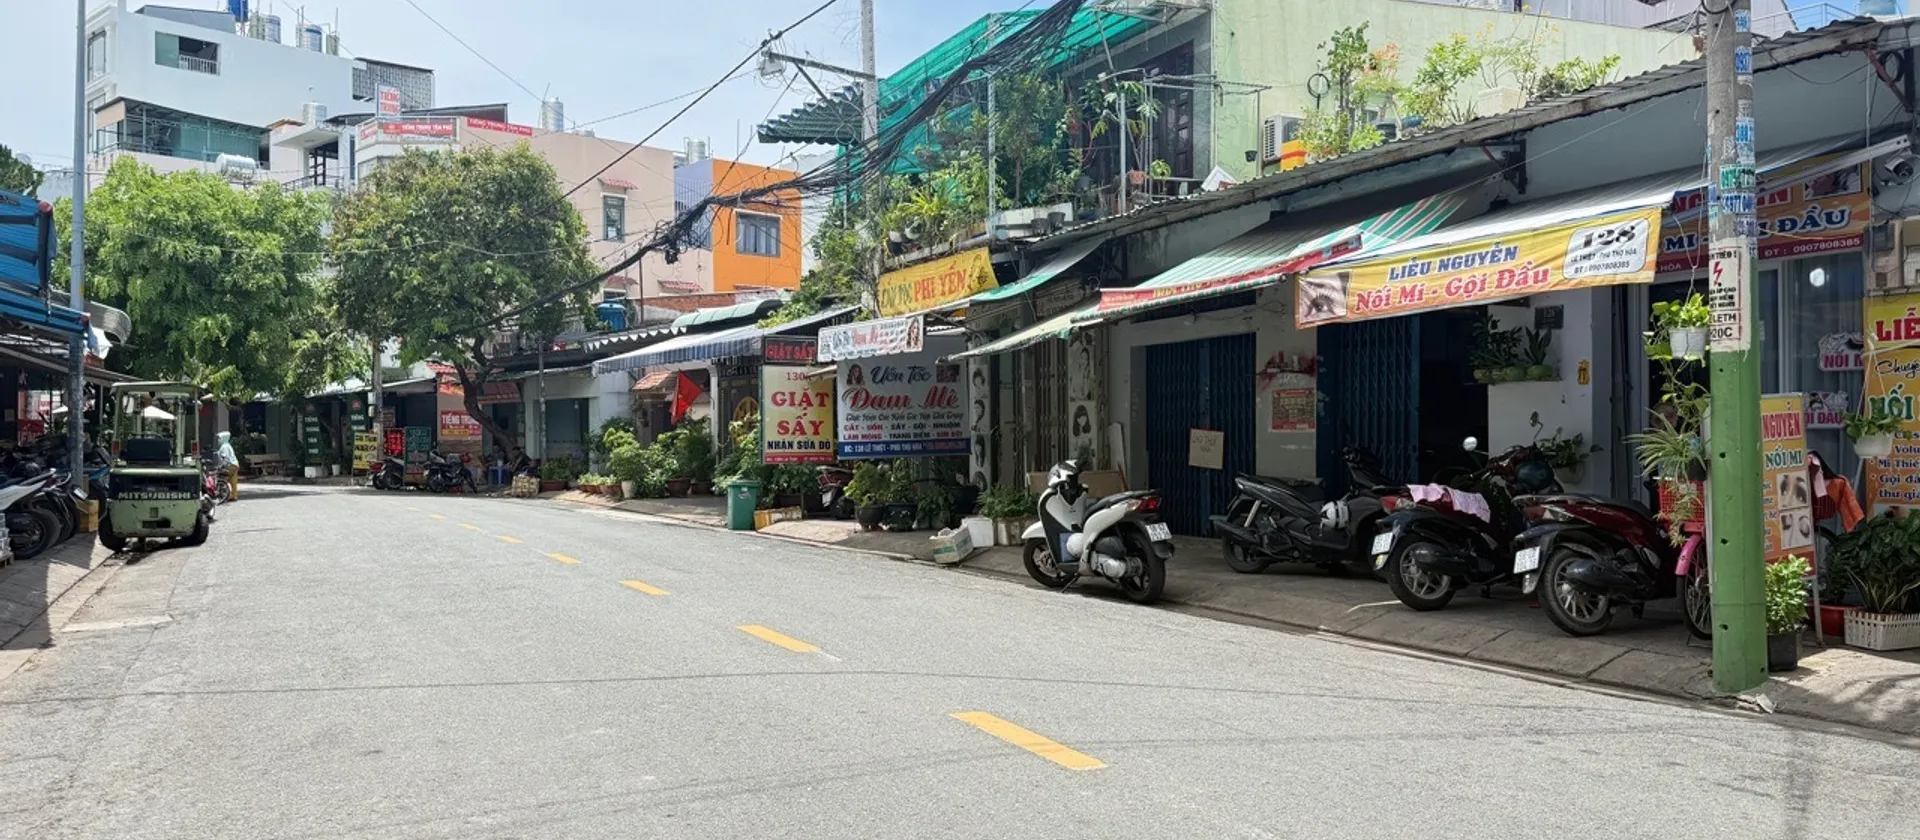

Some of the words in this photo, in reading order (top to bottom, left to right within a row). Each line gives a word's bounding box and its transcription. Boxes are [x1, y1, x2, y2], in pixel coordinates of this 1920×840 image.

[1777, 204, 1848, 233] ĐẦU
[1583, 225, 1636, 249] 128
[1660, 262, 1682, 273] HÒA
[1792, 238, 1861, 254] 0907808385
[1355, 284, 1393, 311] Nối
[1445, 273, 1488, 299] Gội
[1495, 260, 1551, 290] Đầu
[1710, 326, 1733, 339] 20C
[771, 388, 830, 410] GIẶT
[777, 412, 824, 436] SẤY
[118, 491, 191, 500] MITSUBISHI
